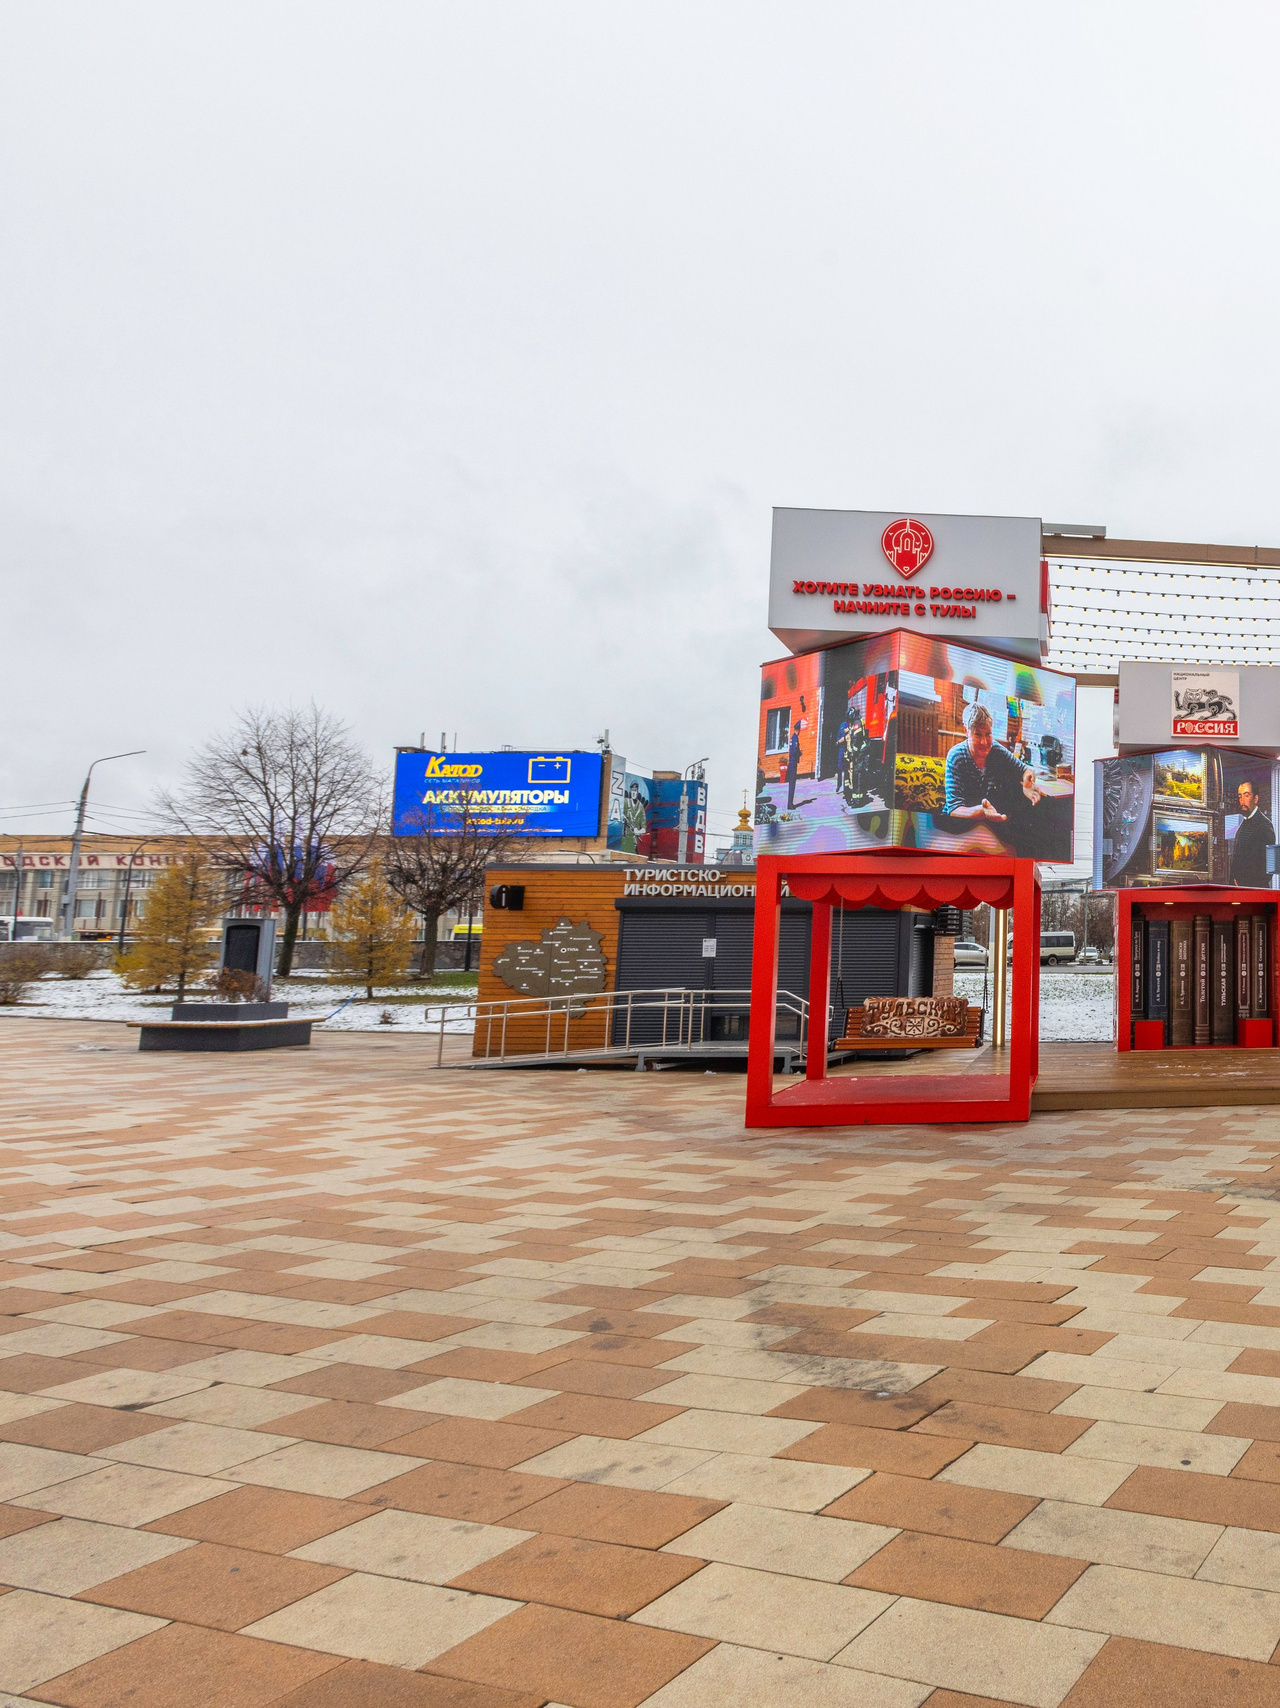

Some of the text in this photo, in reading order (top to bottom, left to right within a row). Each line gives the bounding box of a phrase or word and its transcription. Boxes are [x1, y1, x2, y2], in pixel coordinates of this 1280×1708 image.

[792, 580, 859, 596] ХОТИТЕ
[862, 583, 926, 599] УЗНАТЬ
[929, 586, 1003, 601] РОССИЮ
[833, 599, 976, 618] НАЧНИТЕ С ТУЛЫ
[1175, 721, 1235, 734] РОССИЯ
[422, 790, 570, 804] АККУМУЛЯТОРЫ
[623, 868, 727, 882] ТУРИСТСКО-
